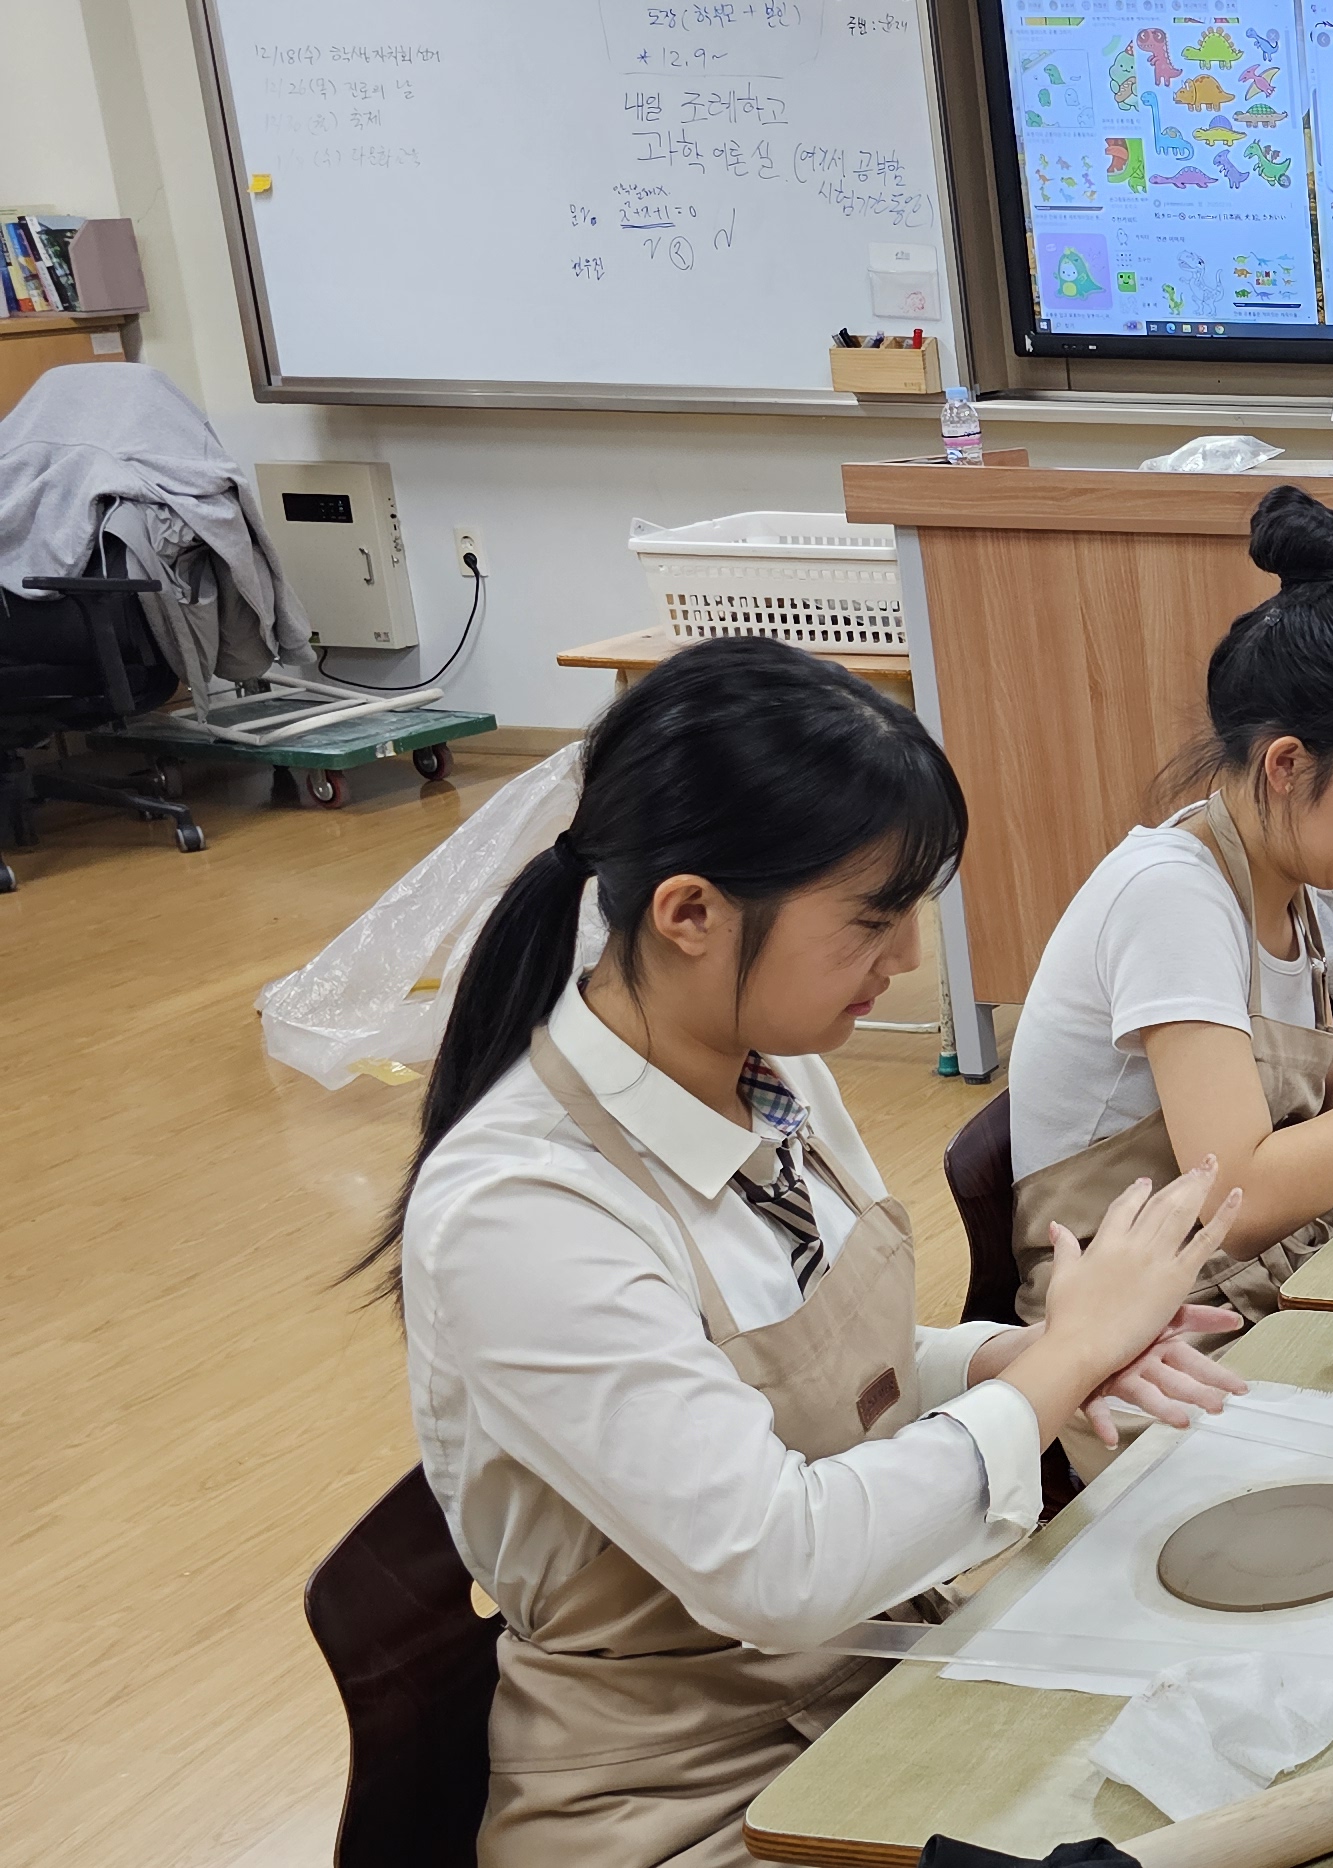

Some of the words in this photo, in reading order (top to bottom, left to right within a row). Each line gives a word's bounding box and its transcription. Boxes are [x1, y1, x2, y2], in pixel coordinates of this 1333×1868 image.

[255, 45, 321, 67] 12/18(수)
[344, 81, 386, 100] 진로의
[396, 79, 415, 99] 날
[625, 92, 662, 121] 내일
[681, 82, 788, 125] 조례하고
[350, 108, 382, 131] 축제
[632, 128, 706, 174] 과학
